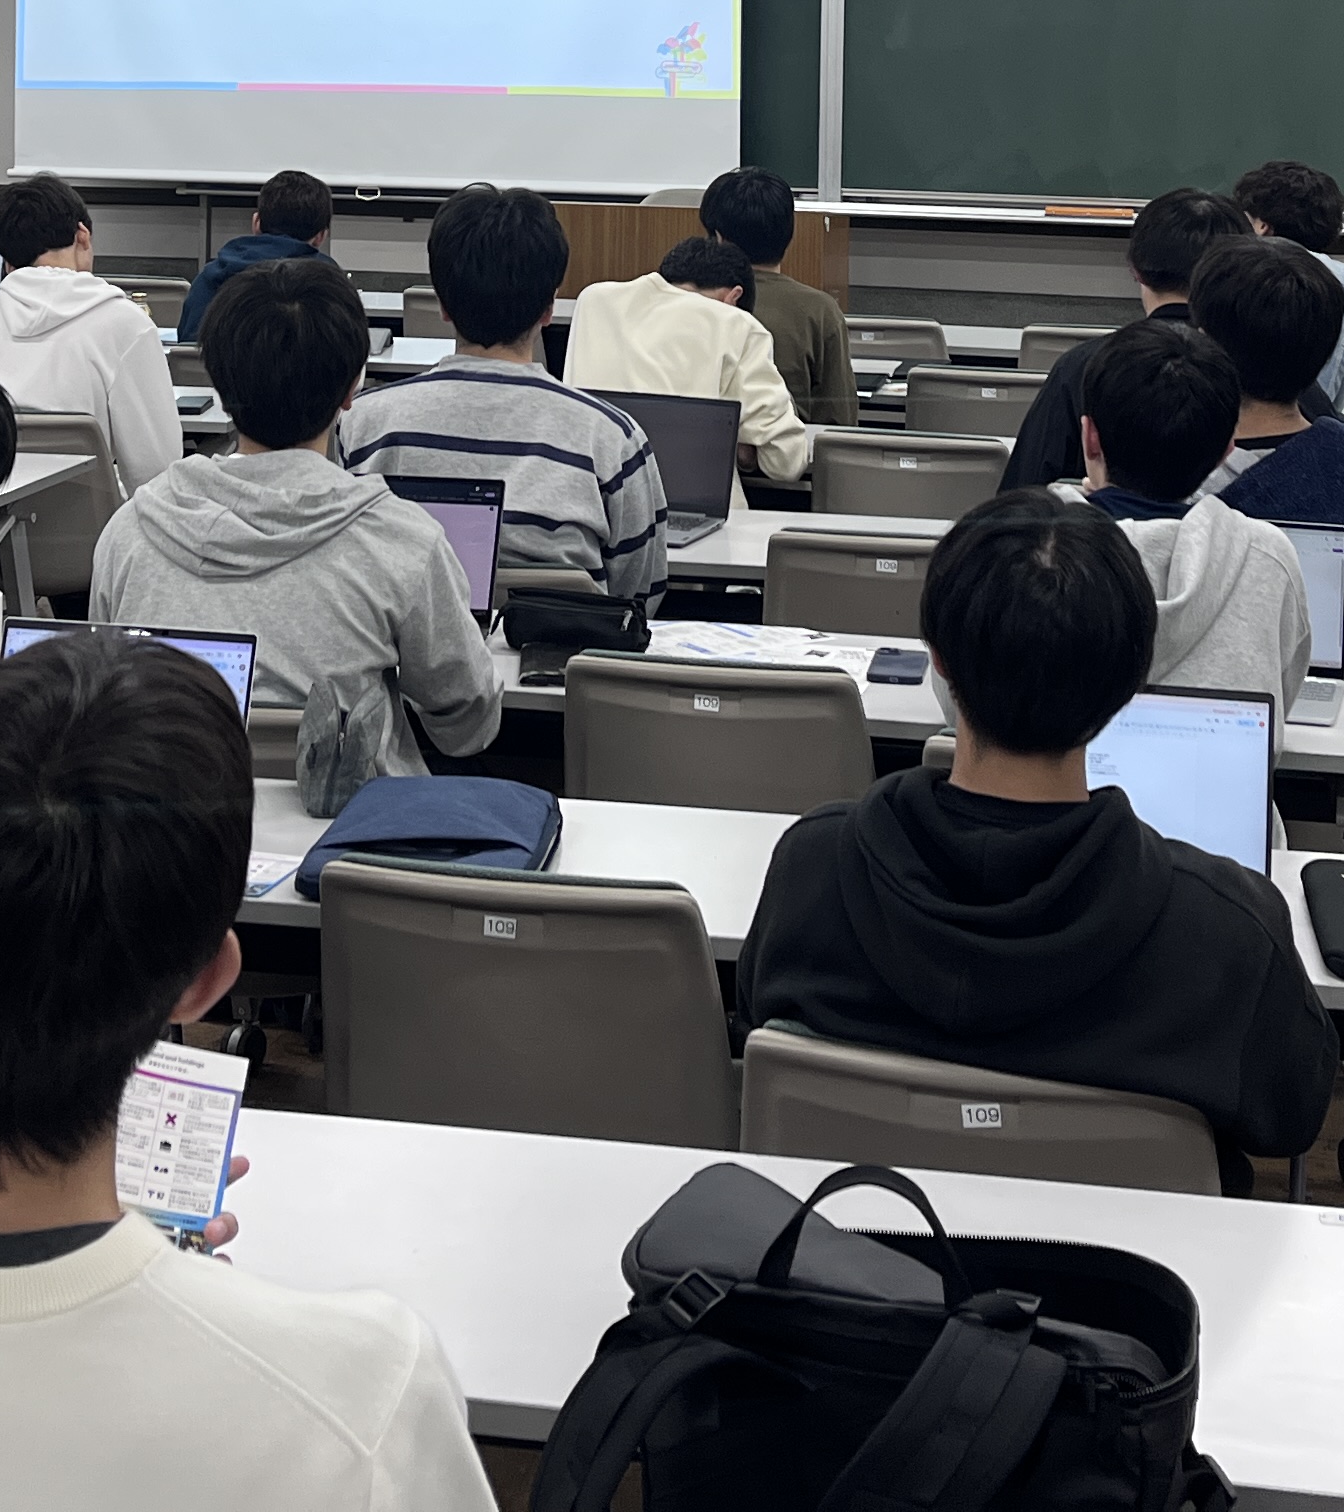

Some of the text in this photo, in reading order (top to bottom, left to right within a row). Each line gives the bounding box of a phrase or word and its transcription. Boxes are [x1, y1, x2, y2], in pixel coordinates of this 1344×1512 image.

[878, 560, 896, 570] 109
[697, 694, 718, 708] 109
[487, 918, 515, 934] 109
[966, 1107, 999, 1123] 109
